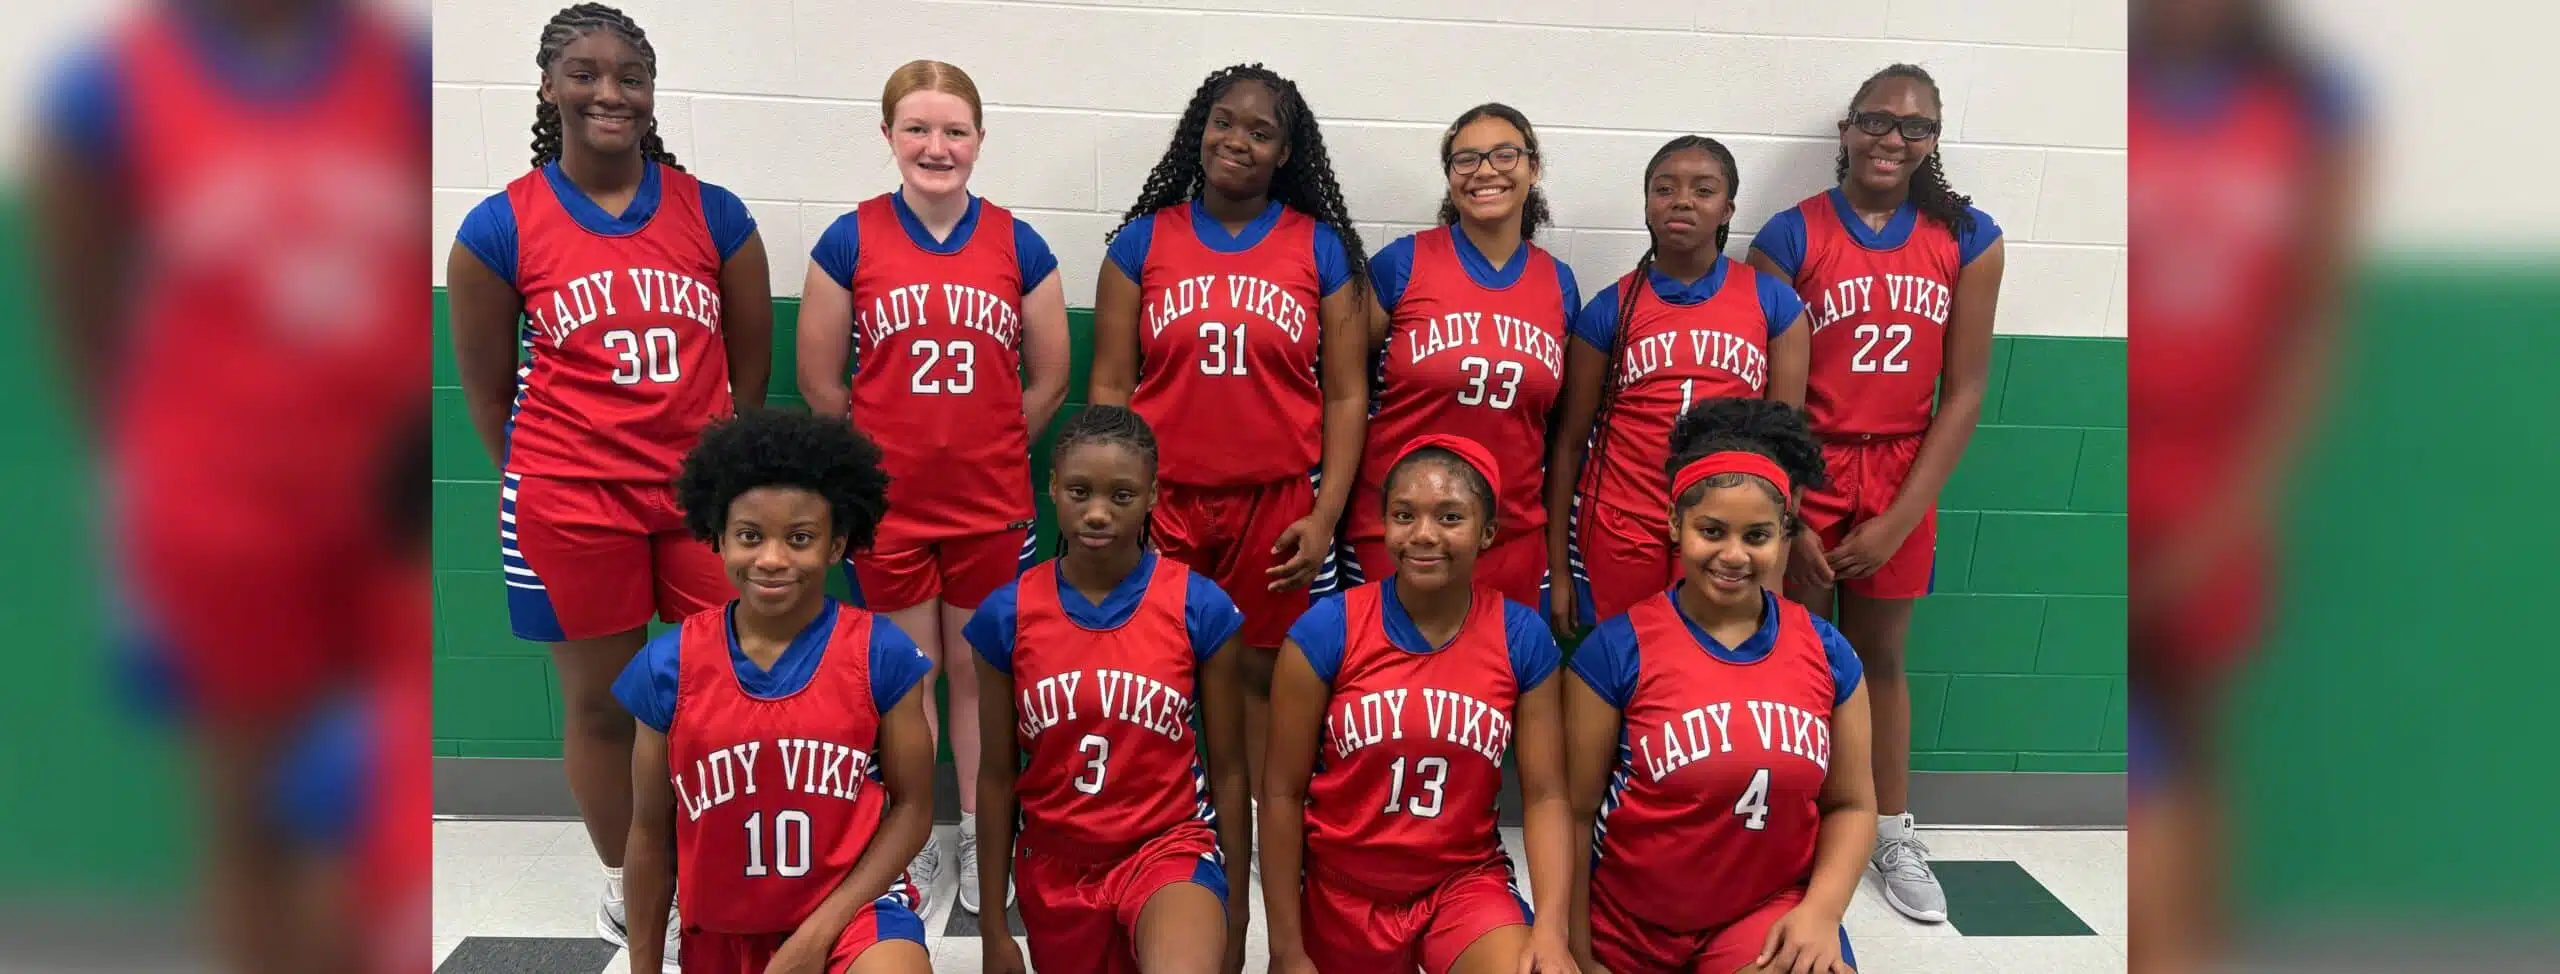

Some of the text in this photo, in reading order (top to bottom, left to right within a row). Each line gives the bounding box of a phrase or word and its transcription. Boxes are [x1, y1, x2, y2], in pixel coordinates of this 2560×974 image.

[536, 268, 721, 349] LADY VIKES
[861, 284, 1018, 350] LADY VIKES
[1149, 275, 1306, 343] LADY VIKES
[1805, 276, 1873, 335] LADY
[603, 327, 680, 385] 30
[911, 339, 975, 394] 23
[1199, 322, 1248, 376] 31
[1409, 312, 1562, 380] LADY VIKES
[1690, 330, 1766, 391] VIKES
[1852, 324, 1912, 373] 22
[1457, 356, 1523, 410] 33
[1676, 378, 1693, 420] 1
[1097, 670, 1188, 741] VIKES
[1328, 688, 1408, 759] LADY
[1074, 734, 1109, 794] 3
[1640, 701, 1830, 783] LADY VIKE
[1383, 756, 1448, 818] 13
[1735, 769, 1770, 830] 4
[744, 810, 811, 877] 10
